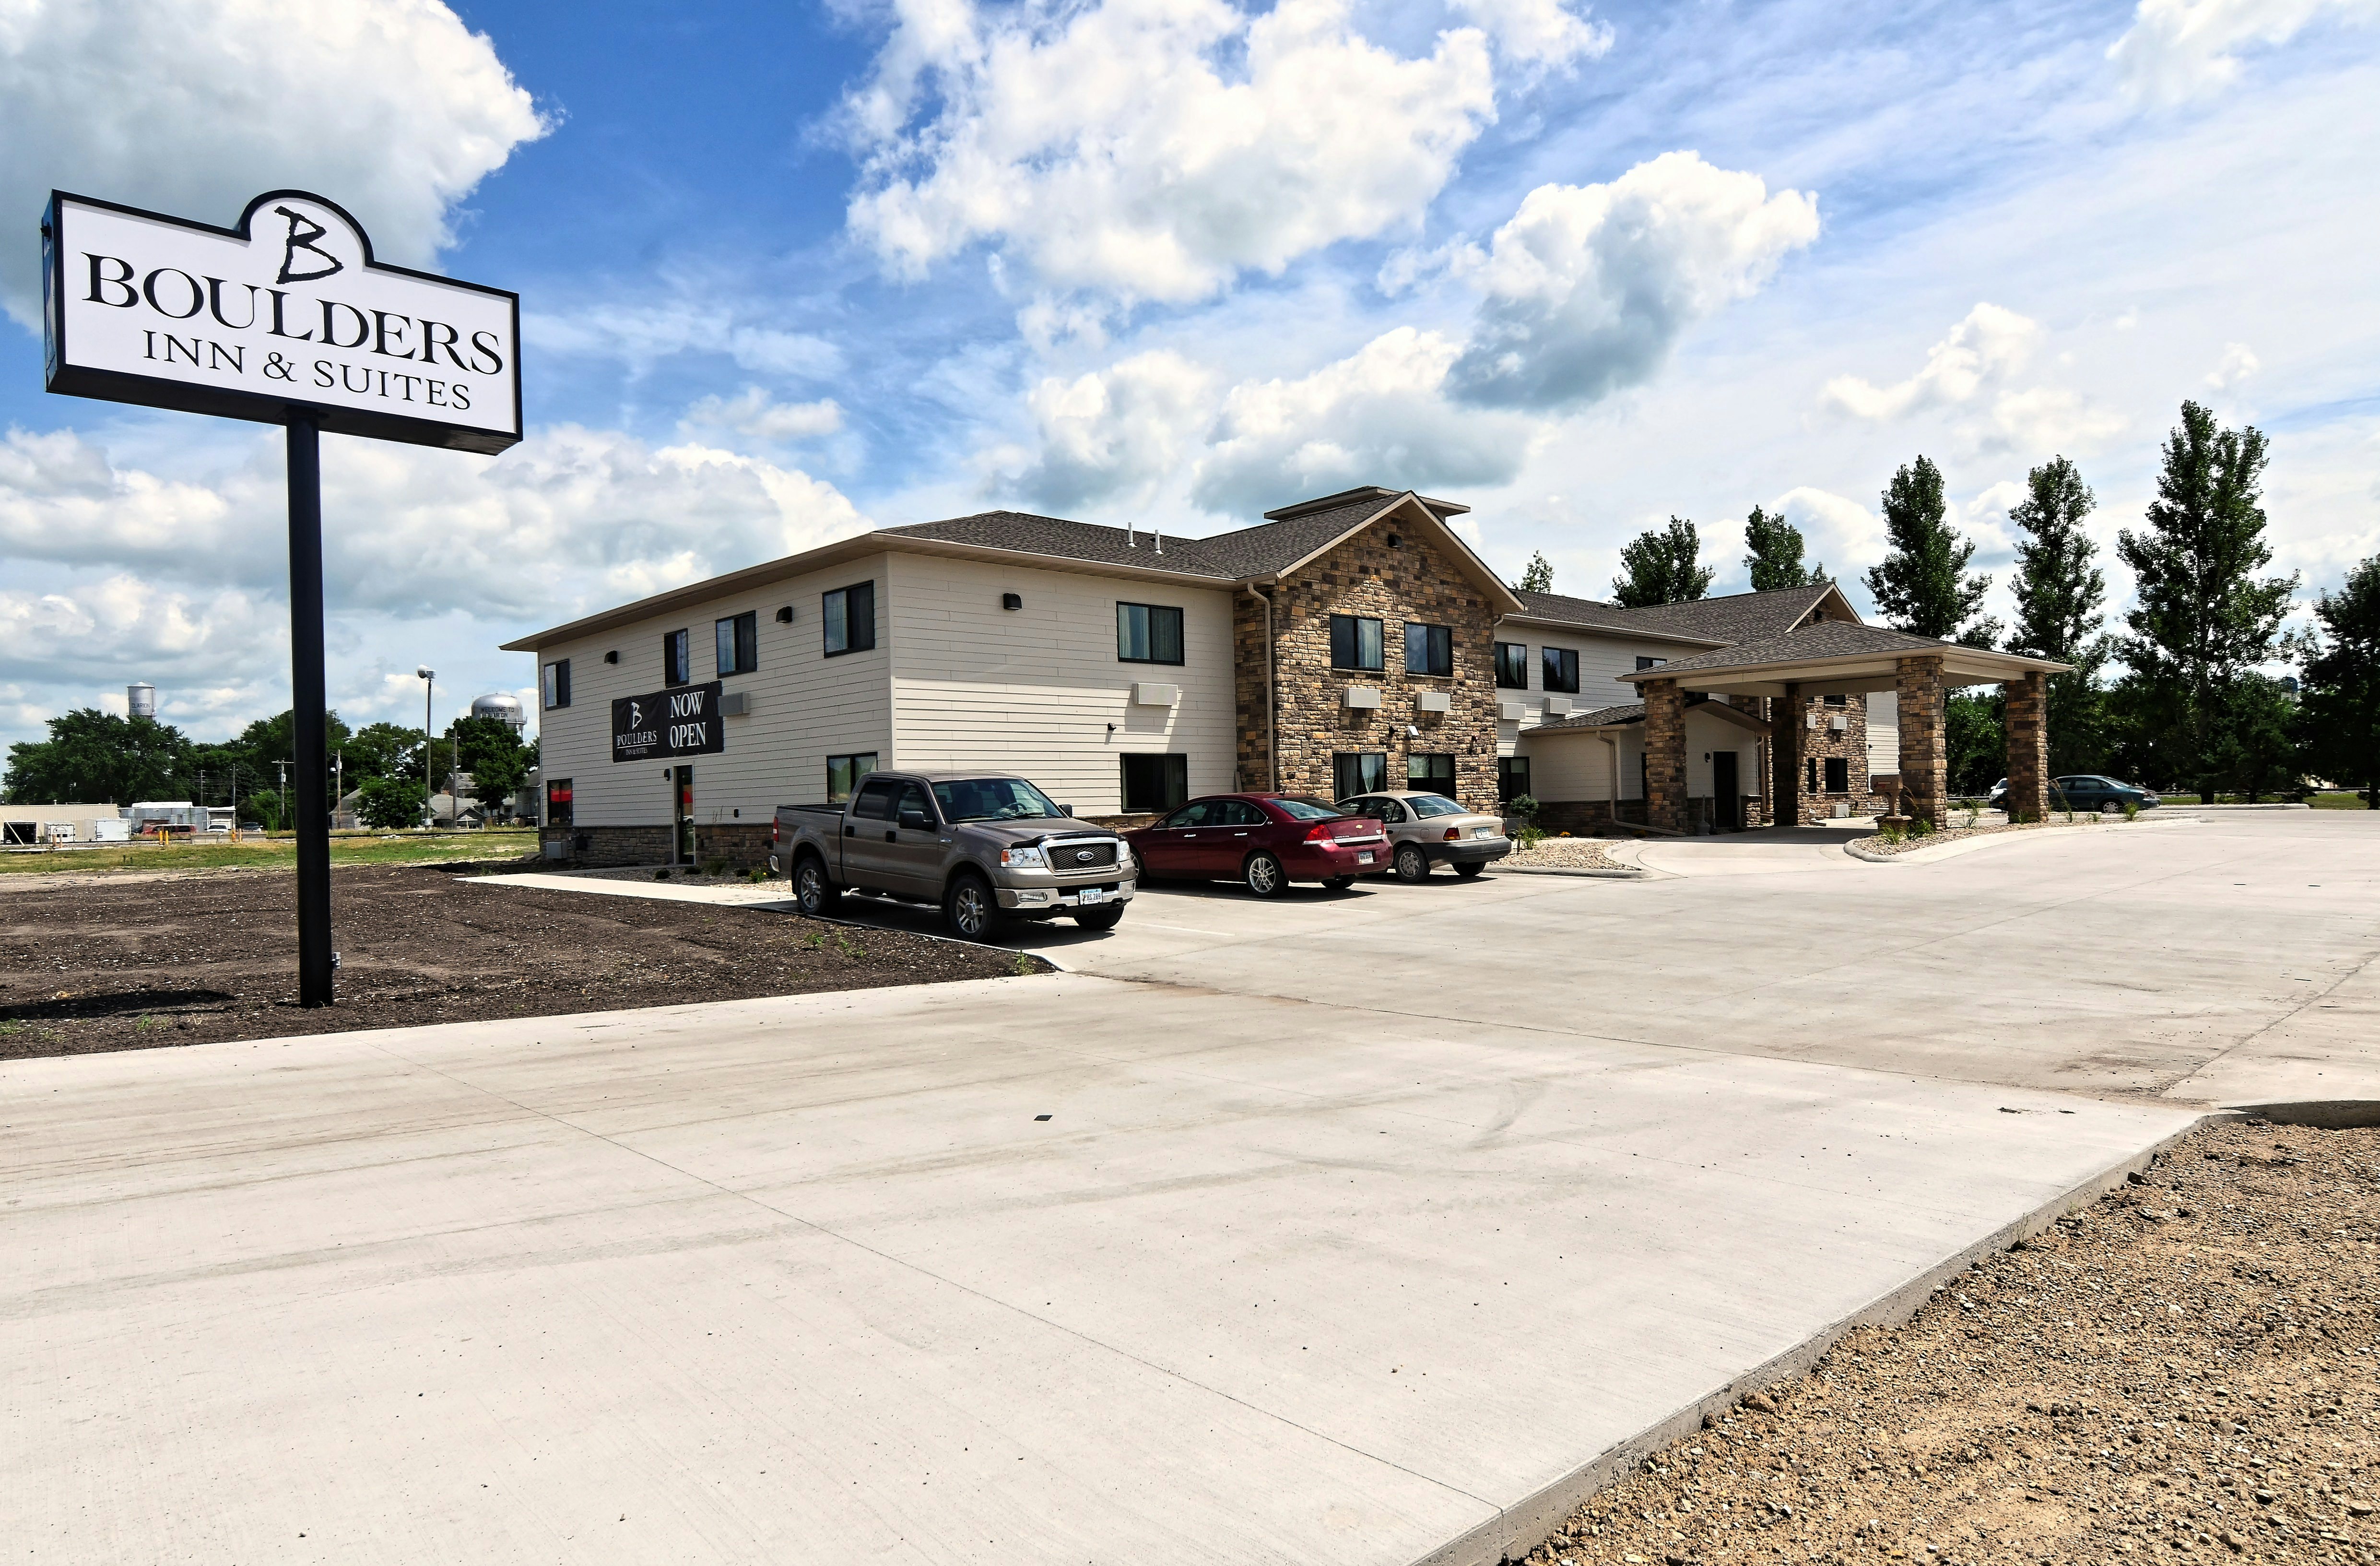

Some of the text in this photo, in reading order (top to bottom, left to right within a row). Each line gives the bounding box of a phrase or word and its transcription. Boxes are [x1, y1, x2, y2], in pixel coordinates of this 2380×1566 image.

[273, 205, 344, 285] B
[81, 251, 503, 375] BOULDERS
[142, 330, 471, 410] INN & SUITES
[631, 702, 642, 730] B
[670, 691, 705, 718] NOW
[617, 730, 657, 746] BOULDERS
[670, 722, 707, 748] OPEN
